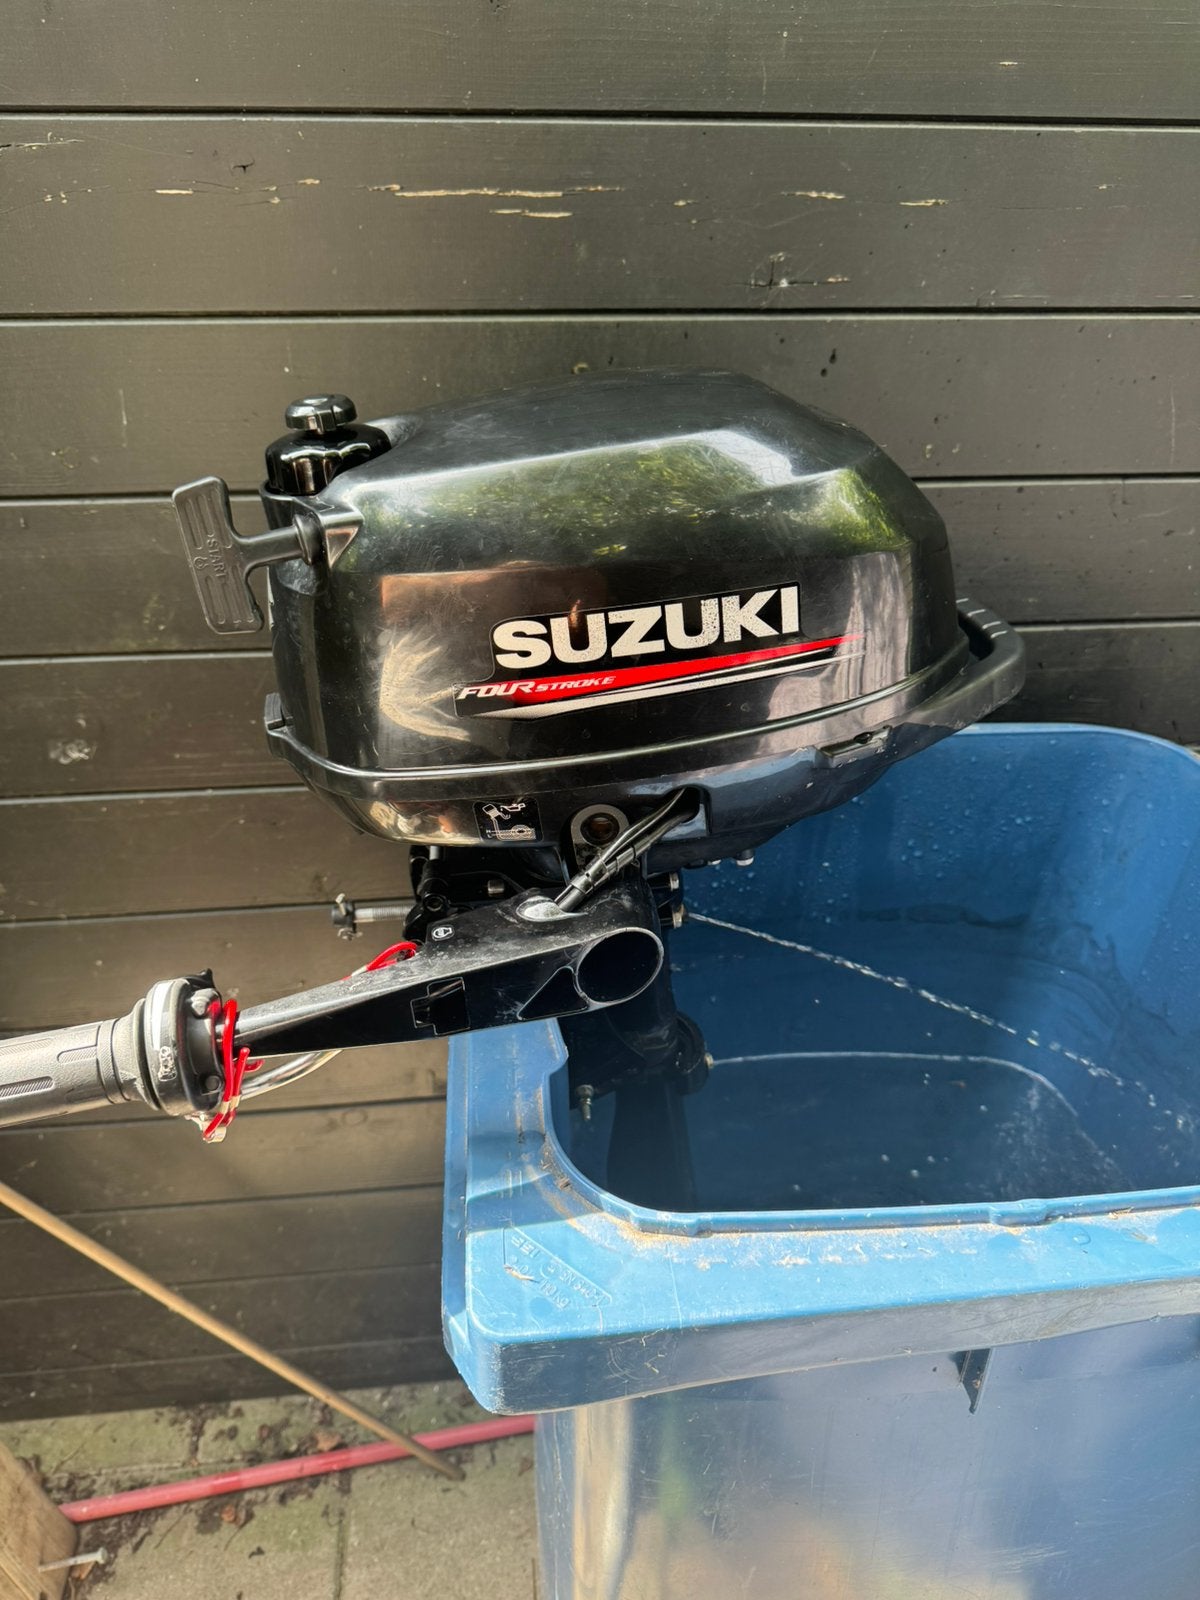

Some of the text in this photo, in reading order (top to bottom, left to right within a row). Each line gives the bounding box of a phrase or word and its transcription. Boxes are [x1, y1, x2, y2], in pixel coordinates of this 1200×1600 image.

[207, 538, 226, 577] START
[493, 585, 800, 669] SUZUKI
[457, 675, 616, 700] FOUR STROKE
